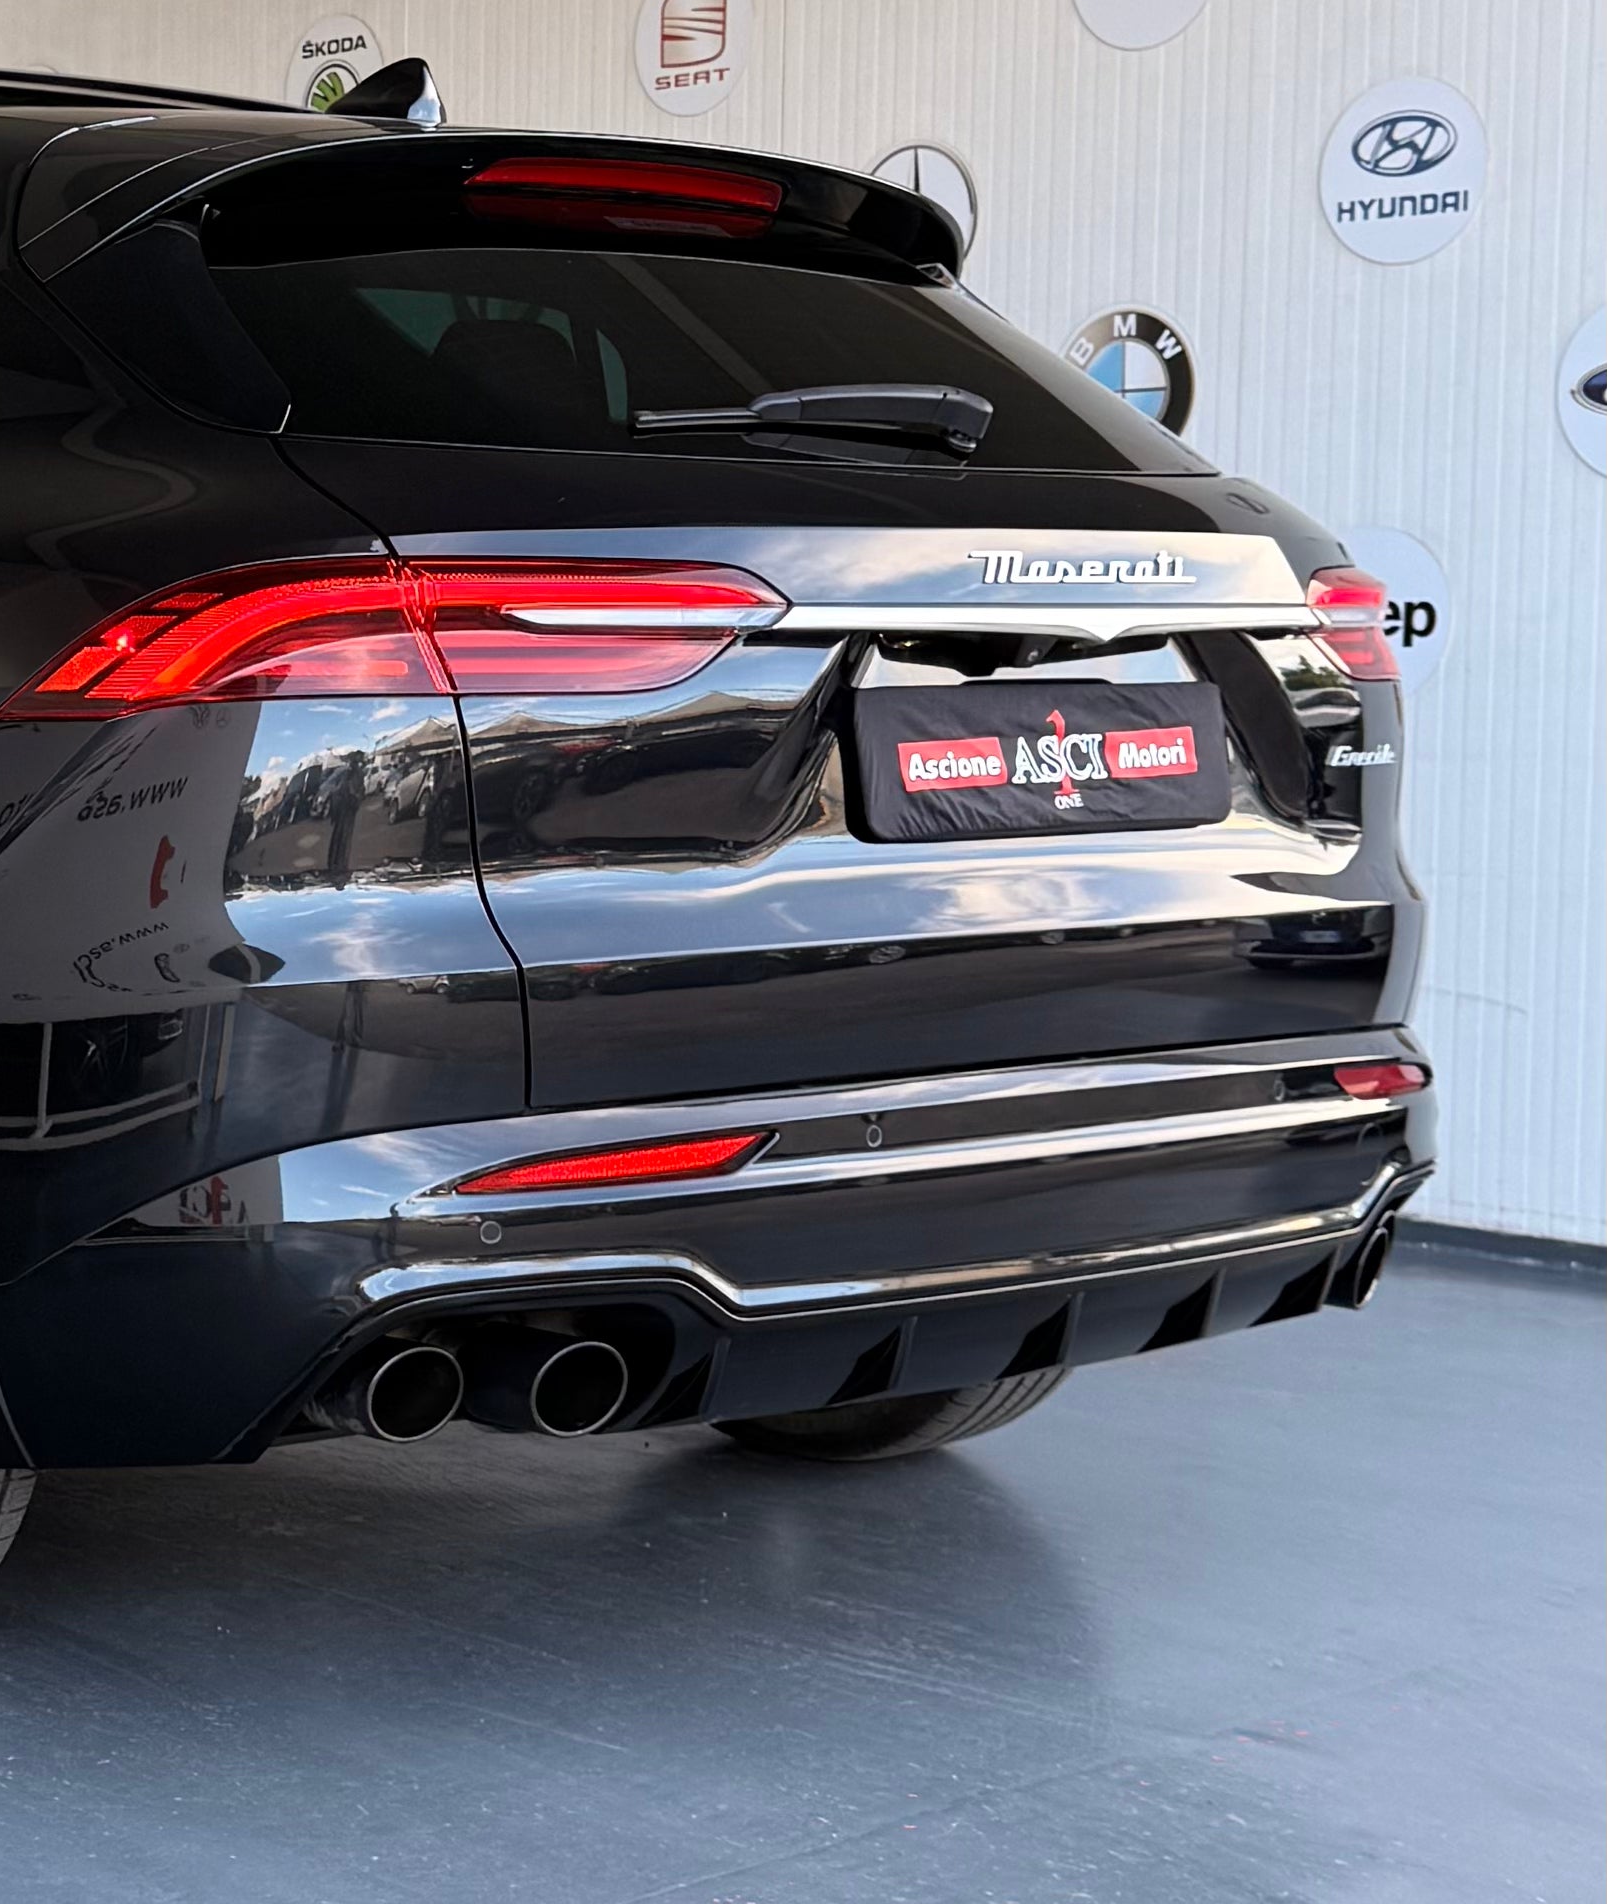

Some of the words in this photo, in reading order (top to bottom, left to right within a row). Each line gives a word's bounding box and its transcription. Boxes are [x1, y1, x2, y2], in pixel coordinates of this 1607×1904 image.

[301, 34, 368, 59] ŠKODA
[654, 67, 731, 91] SEAT
[1336, 189, 1469, 223] HYUNDAI
[1069, 313, 1183, 367] BMW
[966, 549, 1198, 585] Maserati
[1382, 600, 1437, 647] ep
[908, 750, 1002, 781] Ascione
[1117, 737, 1187, 769] Motori
[1053, 793, 1085, 810] ONE
